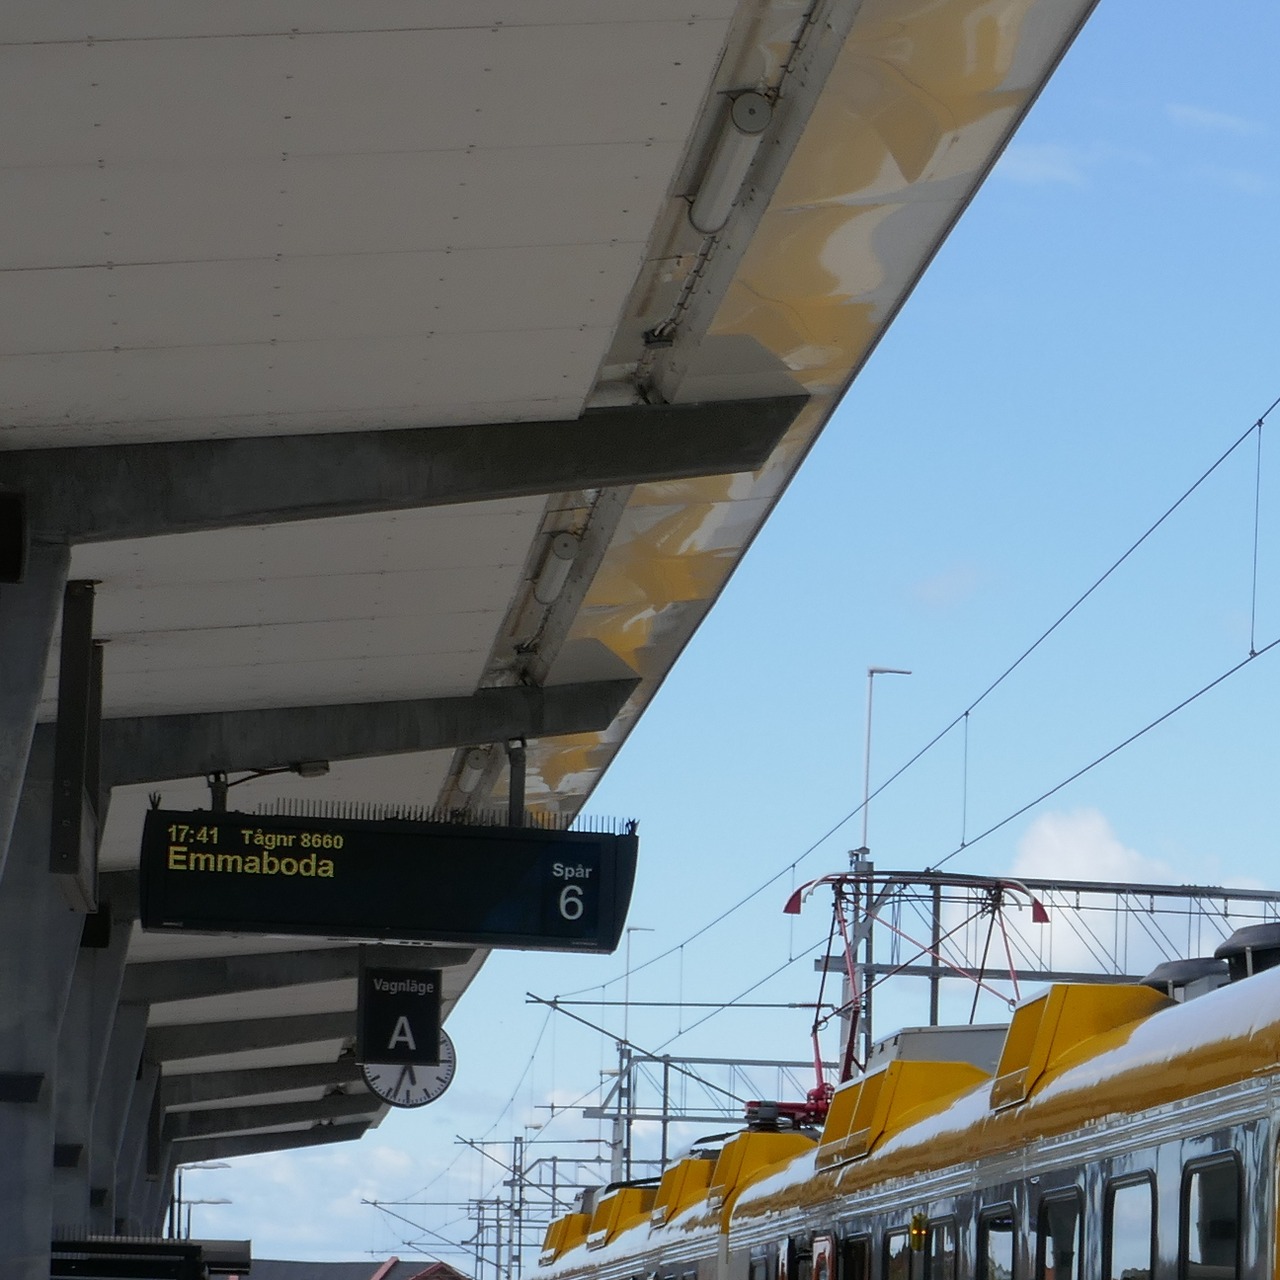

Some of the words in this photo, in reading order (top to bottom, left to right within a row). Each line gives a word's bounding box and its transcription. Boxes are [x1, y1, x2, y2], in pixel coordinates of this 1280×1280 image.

[168, 824, 218, 844] 17:41
[241, 829, 297, 850] Tågnr
[300, 832, 344, 849] 8660
[168, 846, 335, 877] Emmaboda
[552, 862, 593, 880] Spår
[560, 885, 584, 920] 6
[373, 978, 434, 996] Vagnläge
[387, 1016, 417, 1050] A
